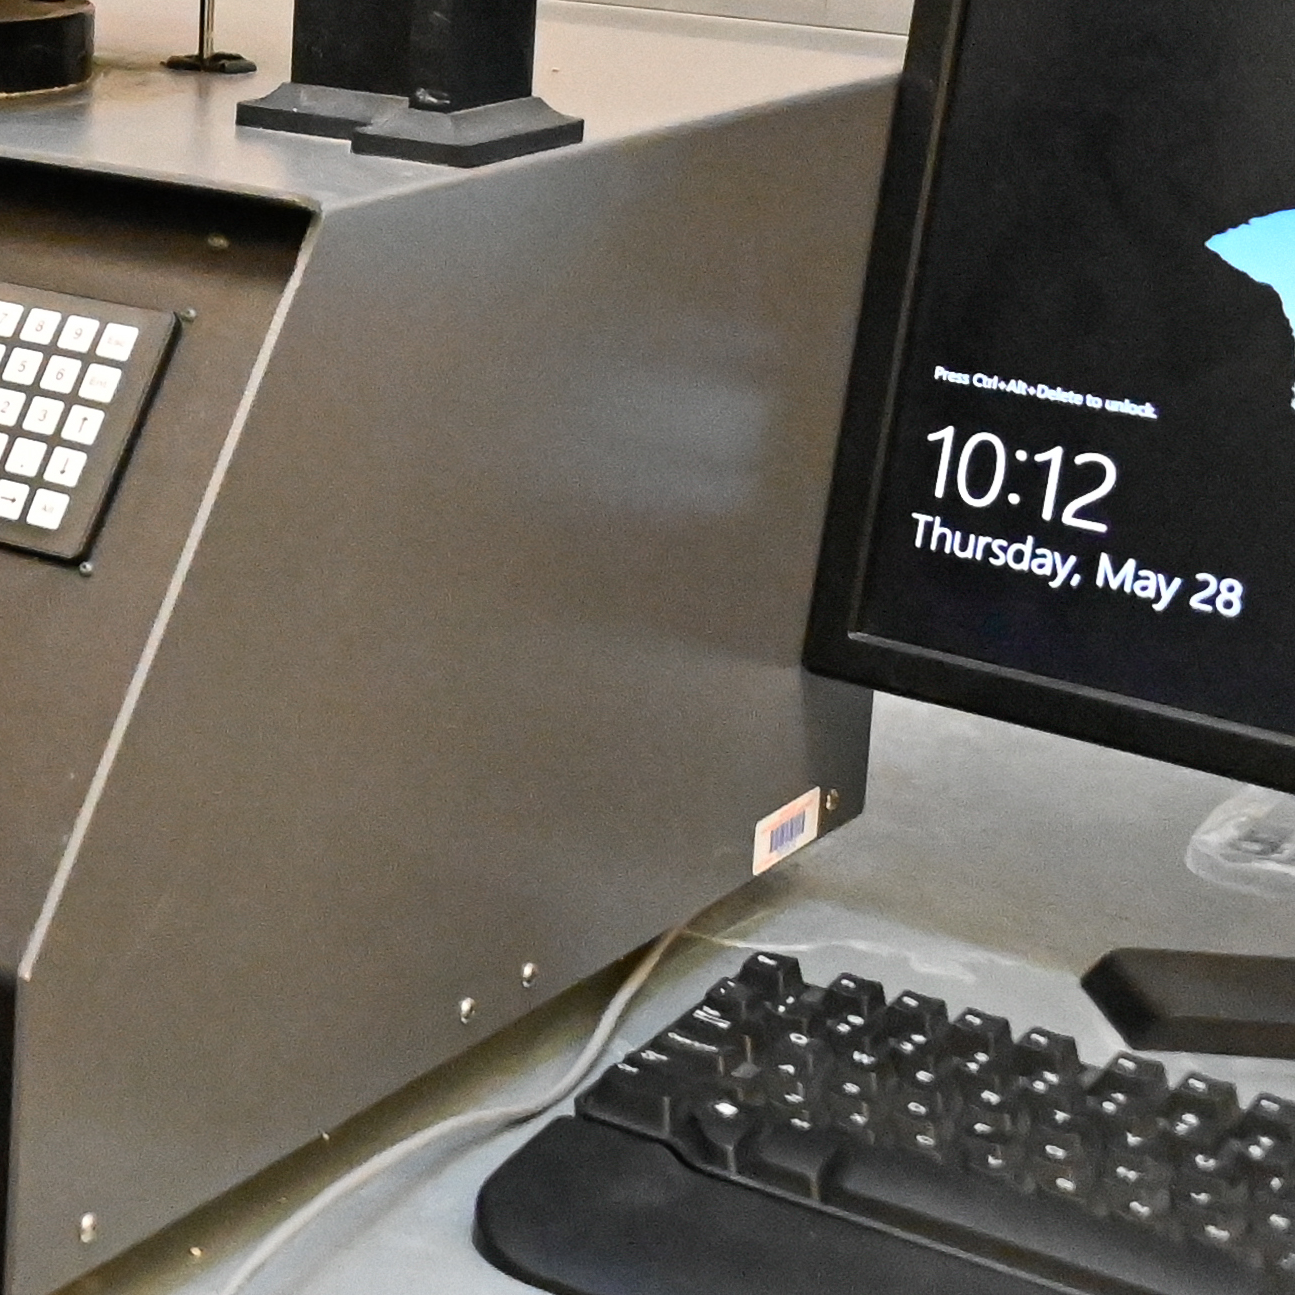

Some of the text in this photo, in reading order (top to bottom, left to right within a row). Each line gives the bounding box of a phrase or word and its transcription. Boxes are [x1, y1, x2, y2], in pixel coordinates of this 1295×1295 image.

[35, 320, 45, 332] 8
[73, 328, 83, 340] 9
[18, 360, 27, 372] 5
[56, 368, 66, 380] 6
[934, 365, 1158, 419] Press Ctrl+Alt+Delete to unlock.
[0, 401, 10, 414] 2
[38, 409, 48, 422] 3
[927, 425, 1117, 533] 10:12
[911, 511, 1244, 618] Thursday, May 28
